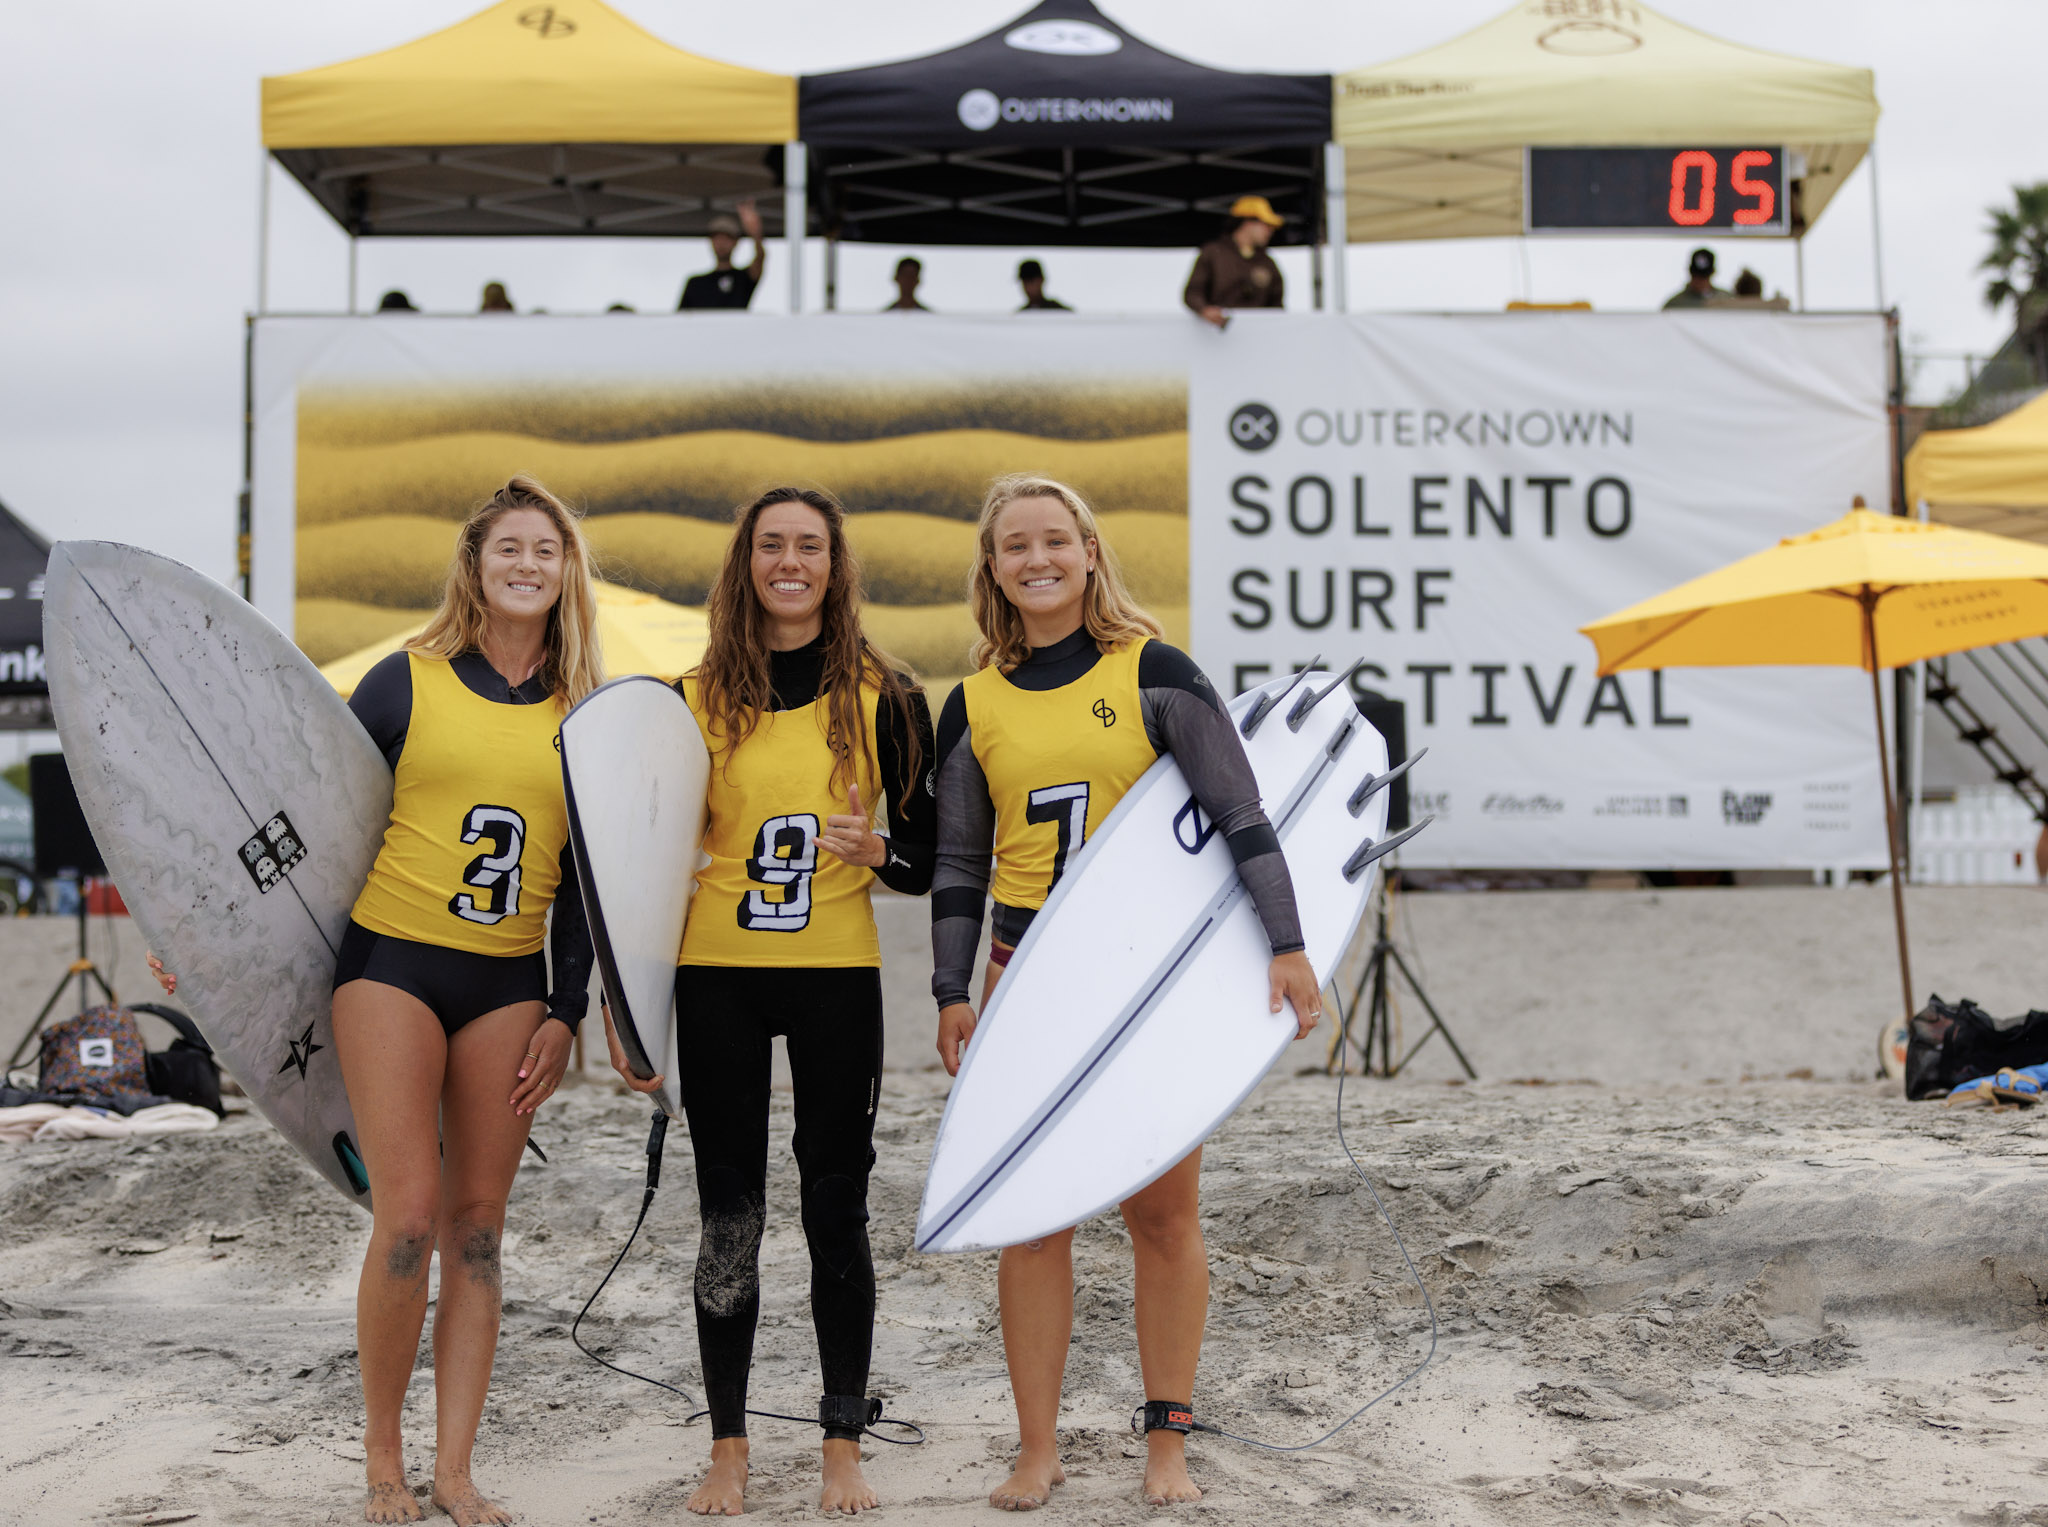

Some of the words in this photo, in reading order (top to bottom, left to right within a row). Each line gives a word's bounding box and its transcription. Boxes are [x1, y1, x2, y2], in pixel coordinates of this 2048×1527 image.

[1001, 97, 1171, 122] OUTERKNOWN
[1669, 151, 1775, 225] 05
[1230, 475, 1633, 537] SOLENTO
[1230, 569, 1453, 632] SURF
[1234, 664, 1690, 726] FSTIVAL
[261, 847, 306, 892] GHOST
[448, 804, 526, 925] 3
[1026, 781, 1090, 897] 7
[737, 813, 820, 932] 9
